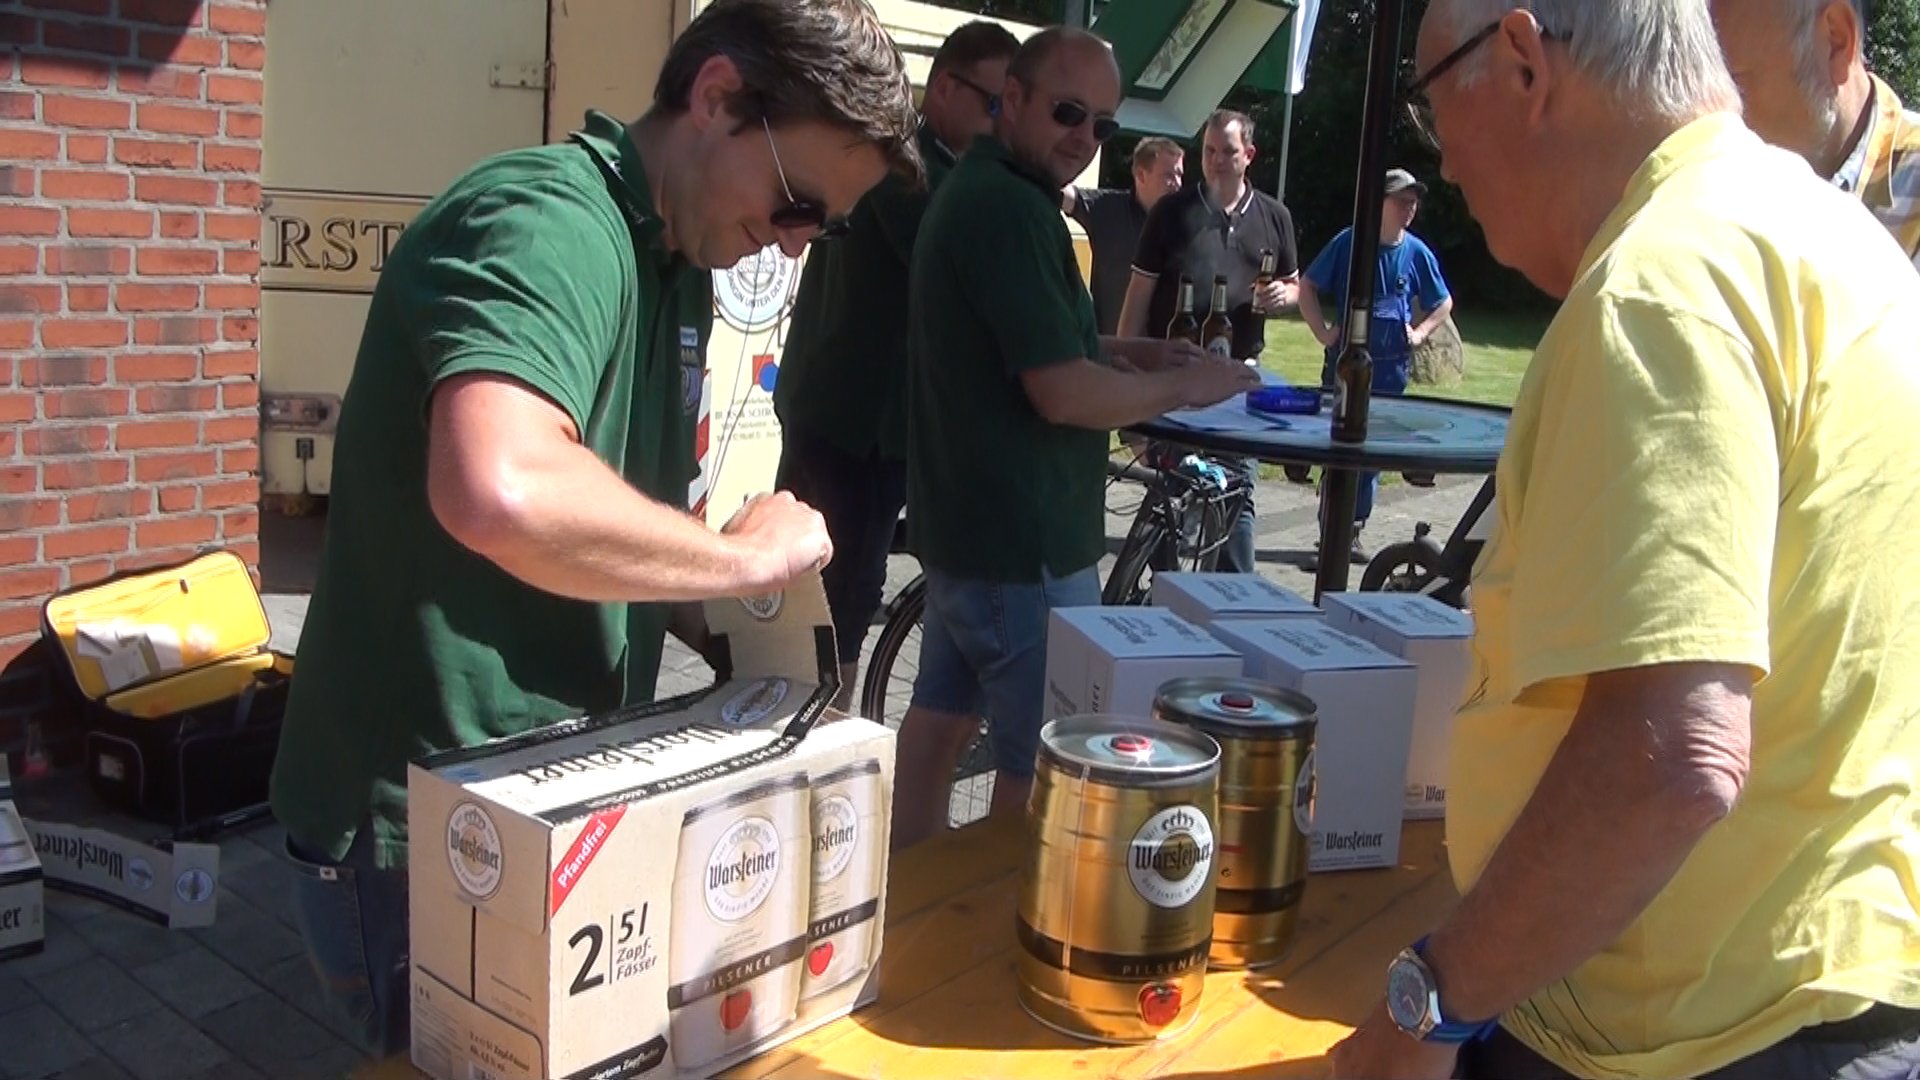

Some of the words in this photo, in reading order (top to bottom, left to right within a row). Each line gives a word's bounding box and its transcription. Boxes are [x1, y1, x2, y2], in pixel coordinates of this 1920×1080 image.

[261, 215, 404, 272] RST
[35, 832, 124, 881] Warsteiner
[449, 825, 500, 870] Warsteiner
[557, 818, 608, 889] Pfandfrei
[1135, 841, 1211, 871] Warsteiner
[1326, 831, 1383, 851] Warsteiner
[709, 851, 776, 890] Warsteiner
[0, 906, 21, 932] er
[567, 922, 604, 997] 2
[616, 937, 653, 964] Zapf-
[704, 954, 772, 991] PILSENER
